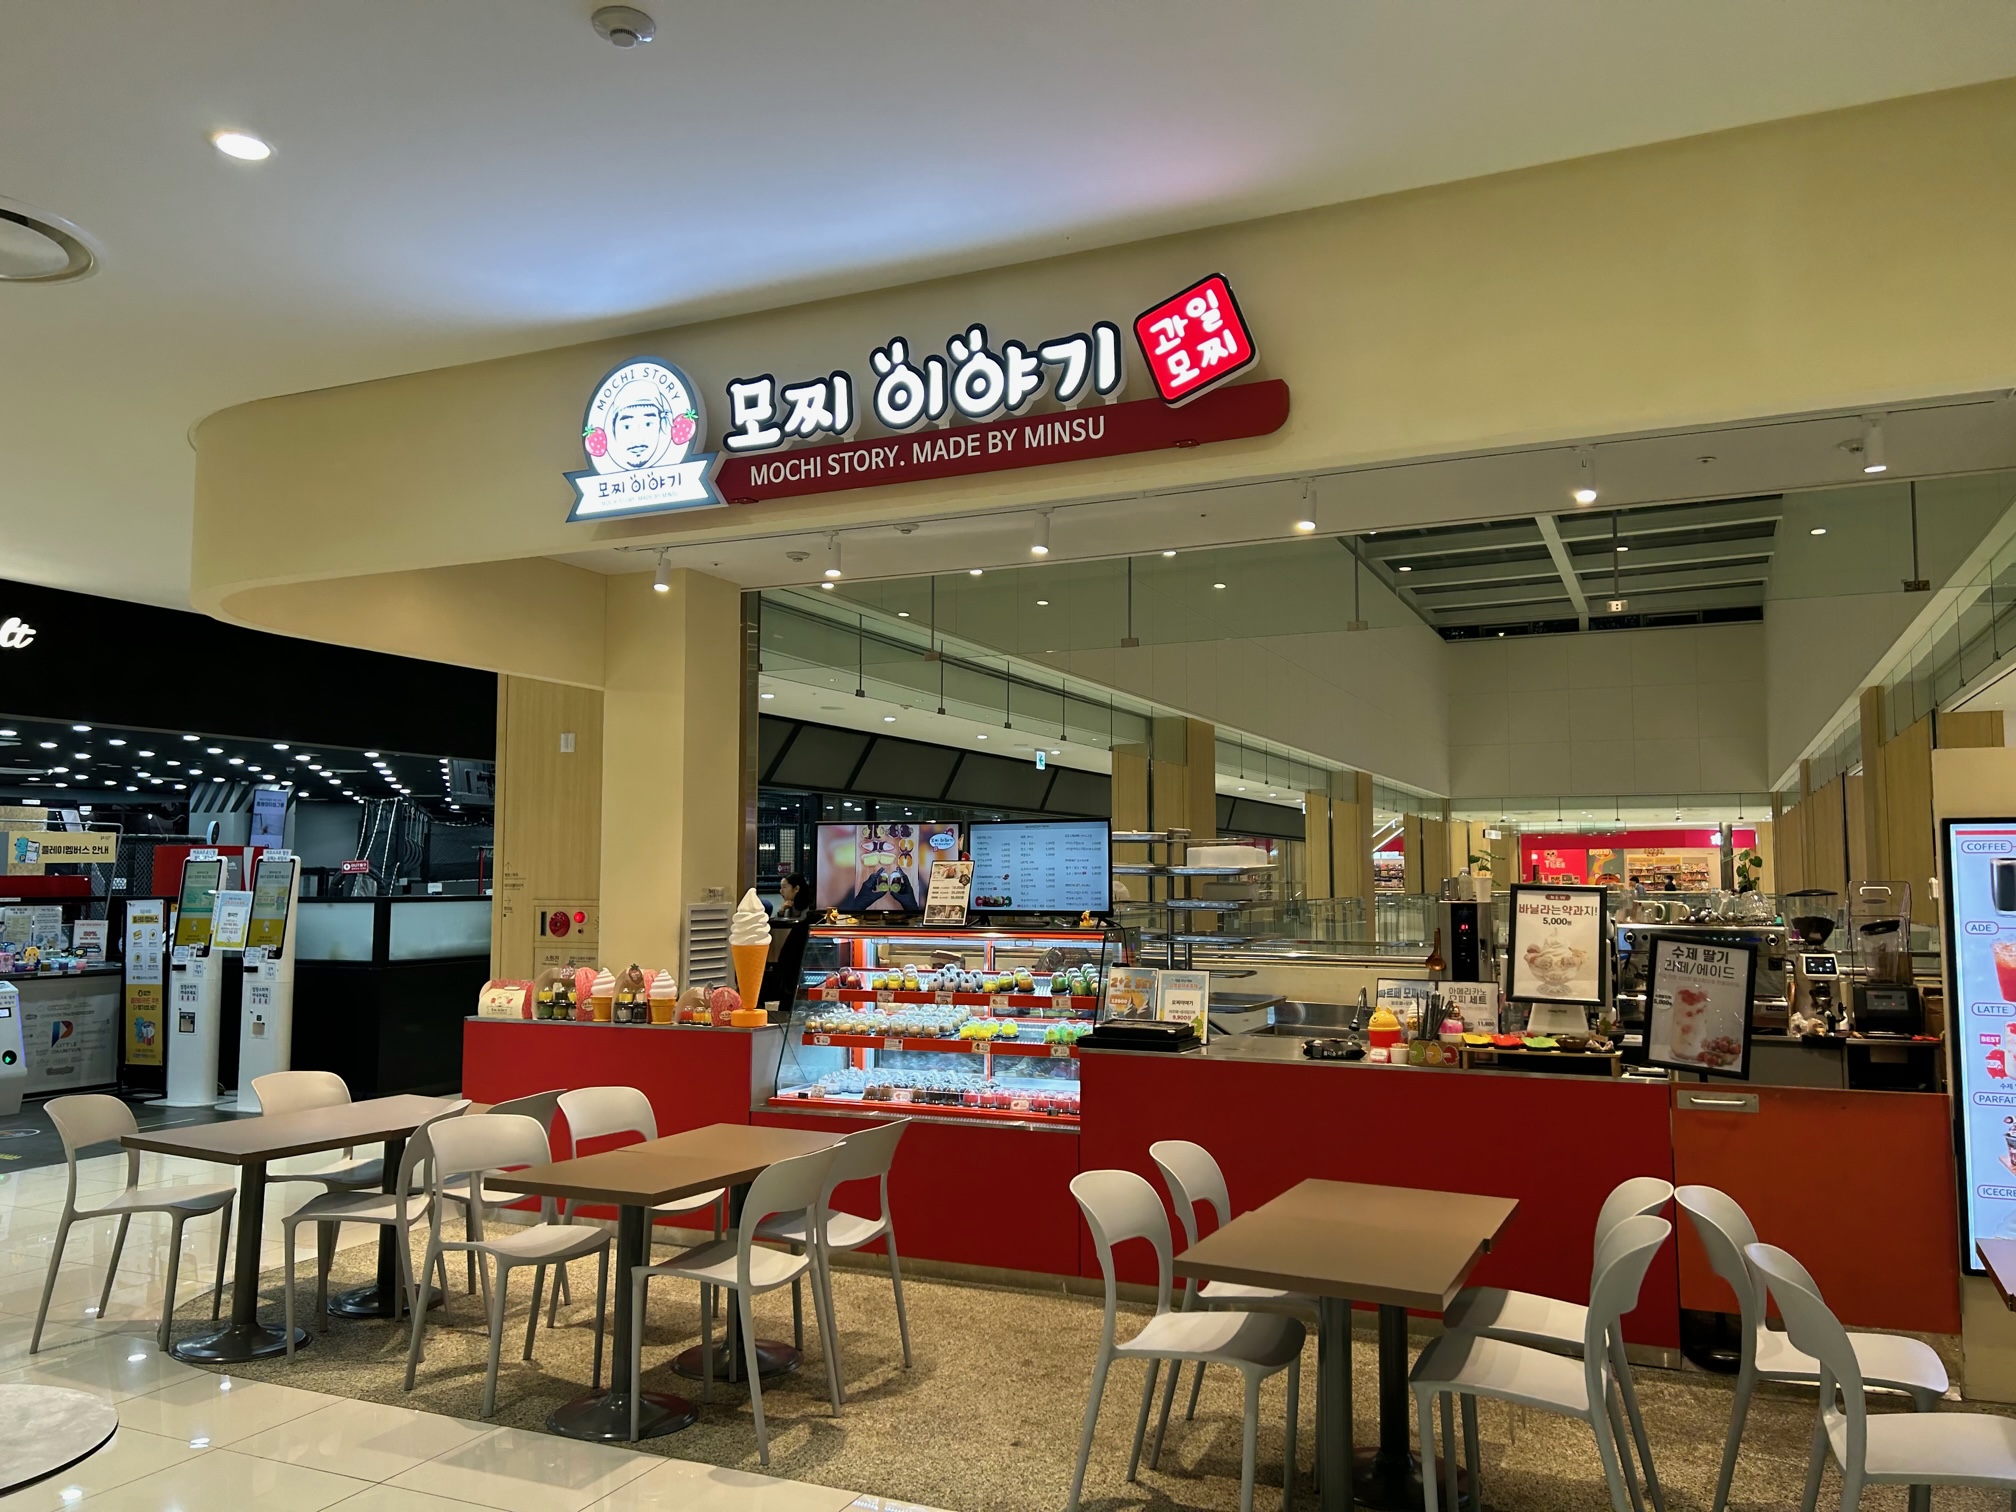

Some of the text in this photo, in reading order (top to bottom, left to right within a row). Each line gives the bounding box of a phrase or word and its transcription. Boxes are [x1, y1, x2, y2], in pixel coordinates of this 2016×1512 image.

[1149, 288, 1223, 355] 과일
[1166, 329, 1237, 387] 모찌
[596, 367, 681, 411] MOCHI STORY
[725, 322, 1119, 449] 모찌 이야기
[750, 415, 1105, 487] MOCHI STORY. MADE BY MINSU
[598, 472, 682, 498] 모찌 이야기
[41, 845, 109, 855] 플레이멤버스 안내
[1967, 842, 2007, 851] COFFEE
[1518, 903, 1598, 917] 바닐라는약과지!
[1971, 923, 1992, 932] ADE
[1672, 946, 1729, 964] 수제 딸기
[1448, 987, 1487, 996] 아메리카노
[1469, 995, 1487, 1005] 세트
[1977, 1005, 2008, 1014] LATTE
